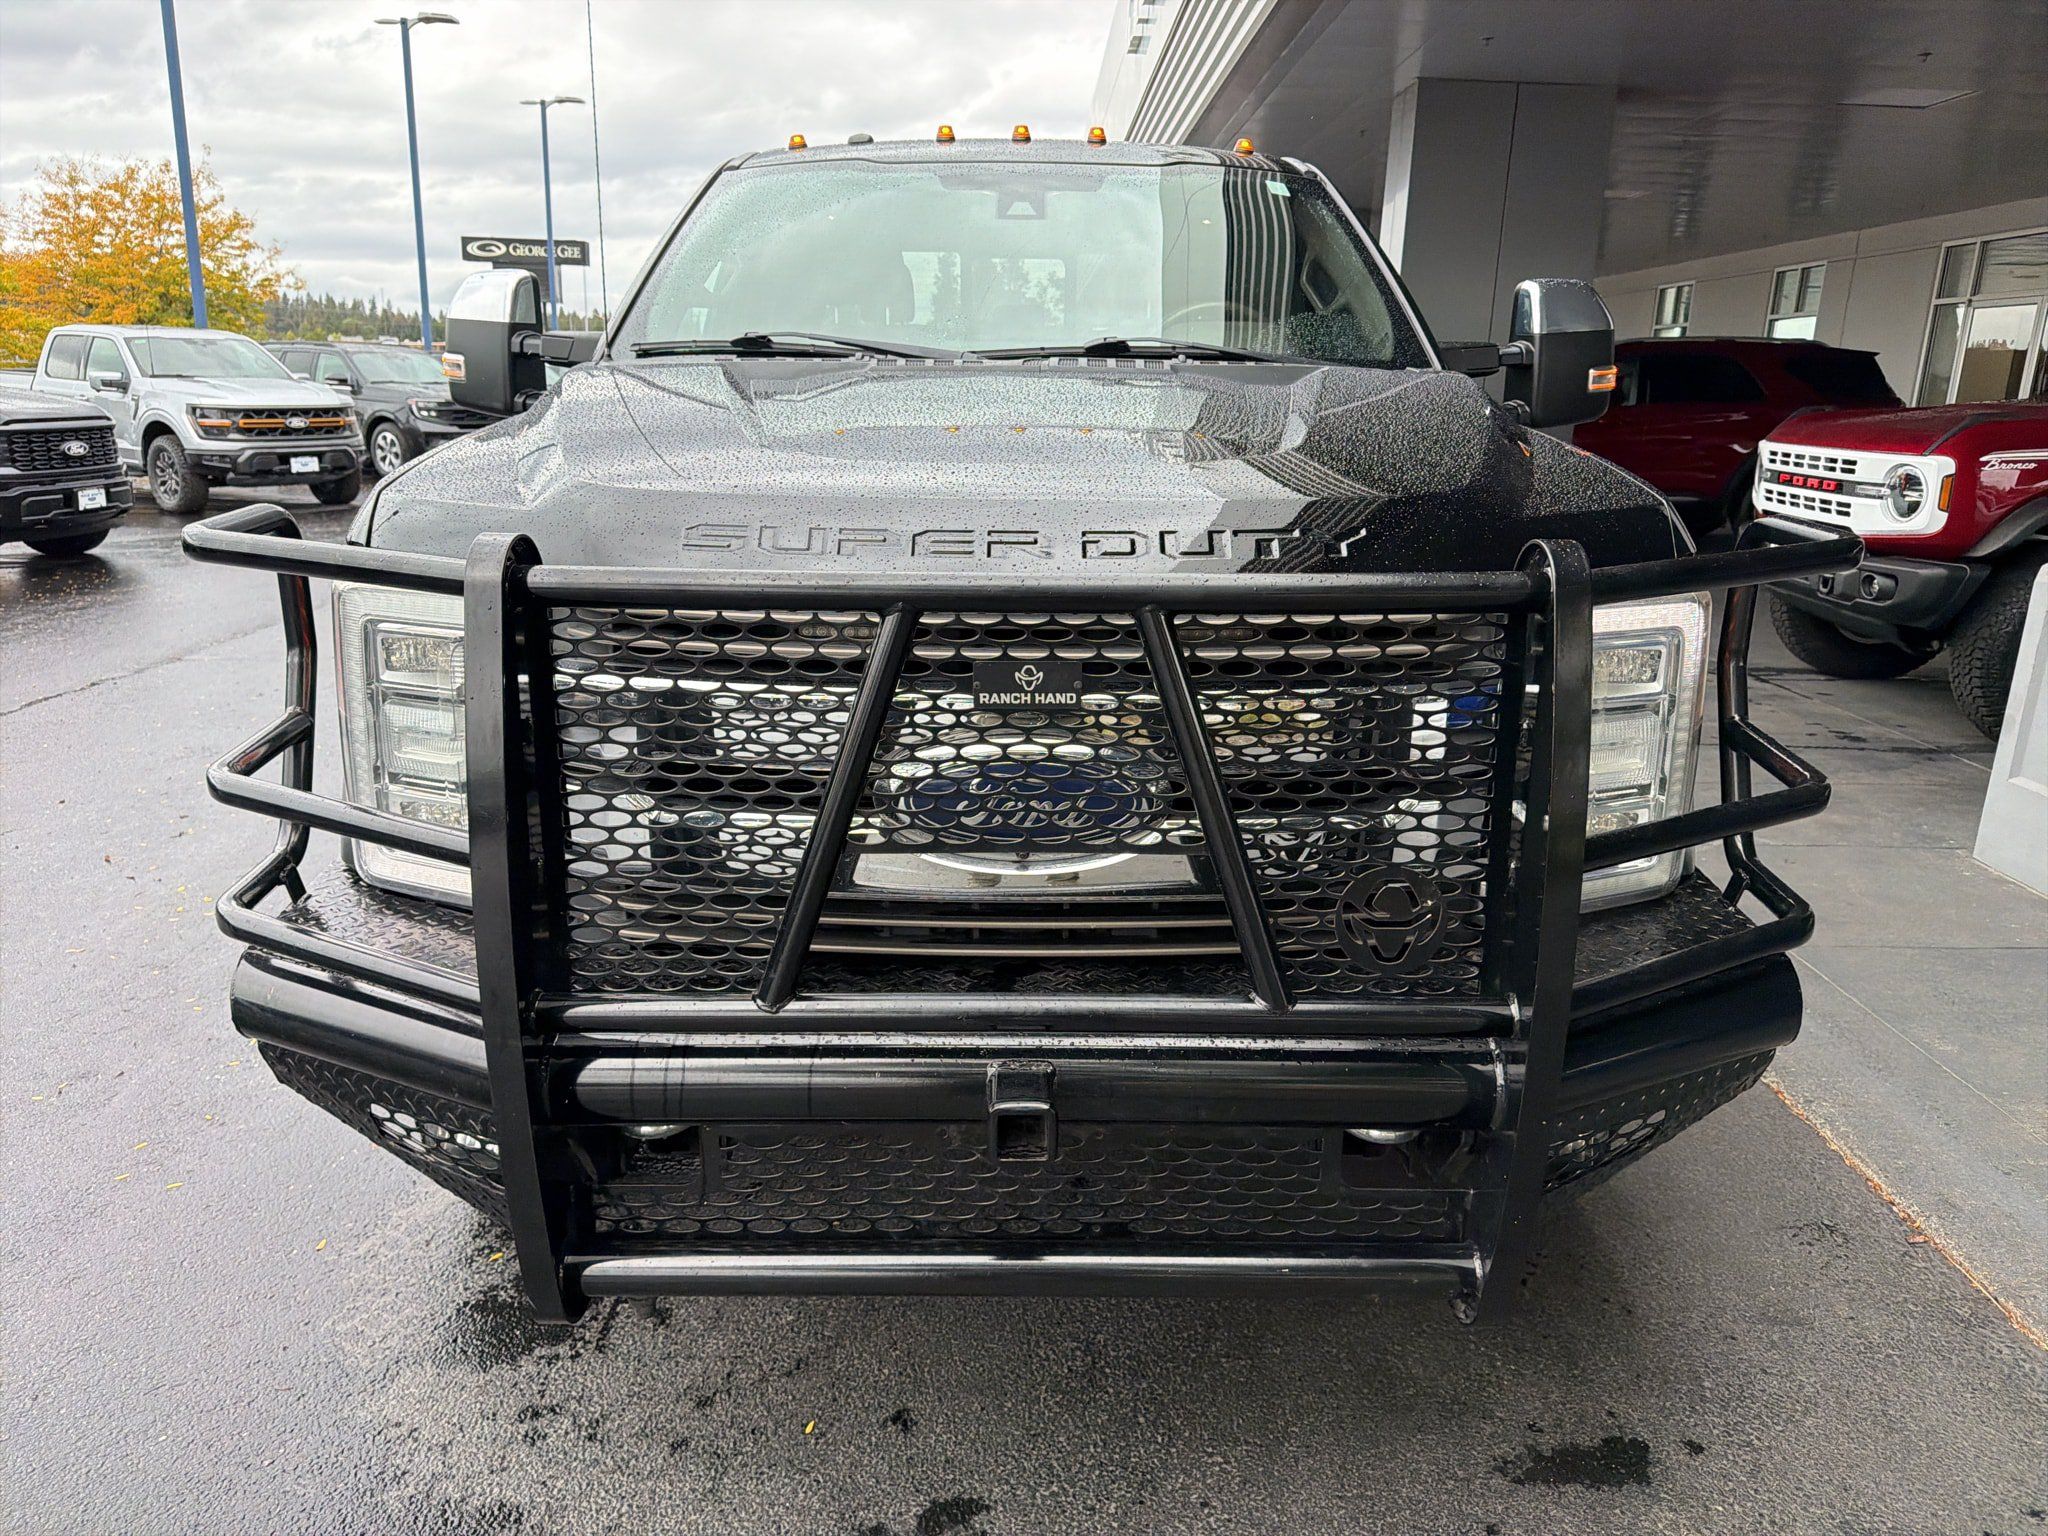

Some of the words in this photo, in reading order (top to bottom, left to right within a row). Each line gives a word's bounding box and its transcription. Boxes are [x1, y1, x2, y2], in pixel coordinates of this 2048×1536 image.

[557, 244, 582, 259] GEE
[1981, 459, 2038, 470] Bronco
[1779, 473, 1837, 491] FORD
[681, 523, 1056, 560] SUPER
[1080, 526, 1367, 561] DUTY
[979, 692, 1031, 705] RANCH
[1035, 692, 1077, 705] HAND
